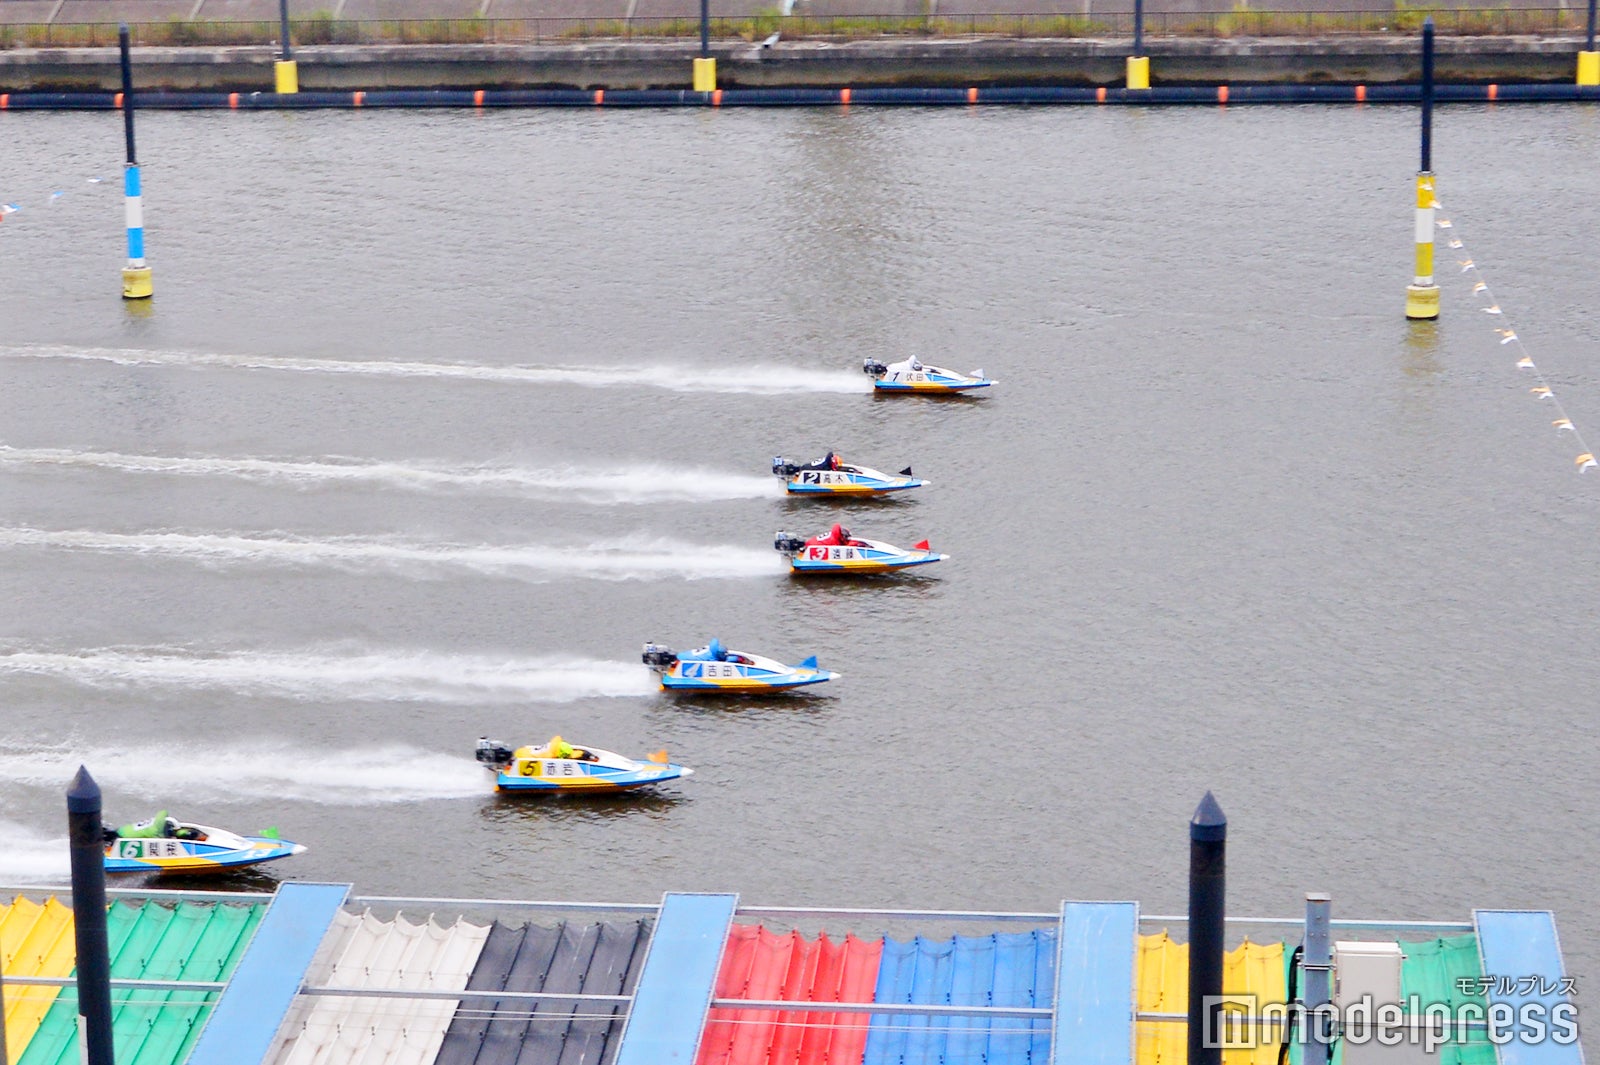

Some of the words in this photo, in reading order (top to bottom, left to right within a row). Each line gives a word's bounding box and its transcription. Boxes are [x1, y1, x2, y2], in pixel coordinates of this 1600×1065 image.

[892, 371, 900, 382] 1
[804, 472, 819, 484] 2
[823, 473, 844, 484] 高木
[811, 547, 827, 560] 3
[684, 663, 701, 677] 4
[708, 665, 733, 677] 吉田
[521, 760, 539, 776] 5
[121, 841, 140, 858] 6
